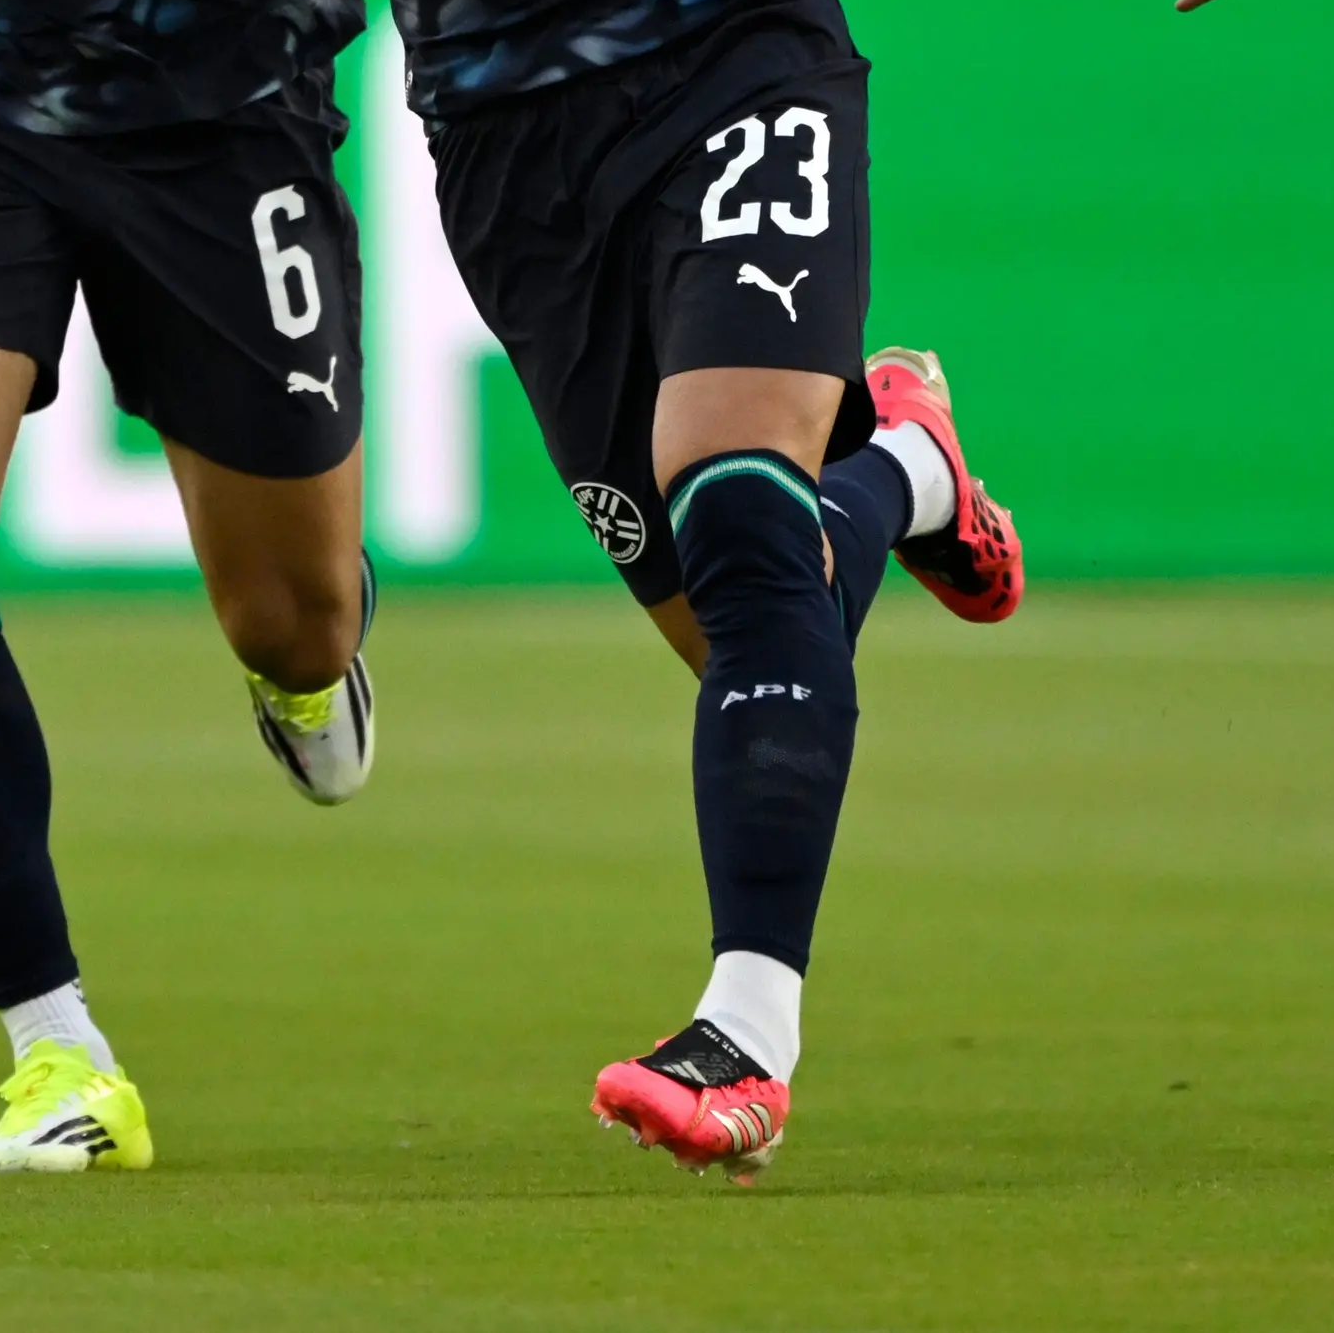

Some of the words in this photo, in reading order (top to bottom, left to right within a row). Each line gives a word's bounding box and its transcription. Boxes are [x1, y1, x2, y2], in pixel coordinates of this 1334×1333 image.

[701, 107, 832, 243] 23
[252, 184, 322, 340] 6
[575, 488, 596, 505] APF
[721, 683, 812, 711] APF
